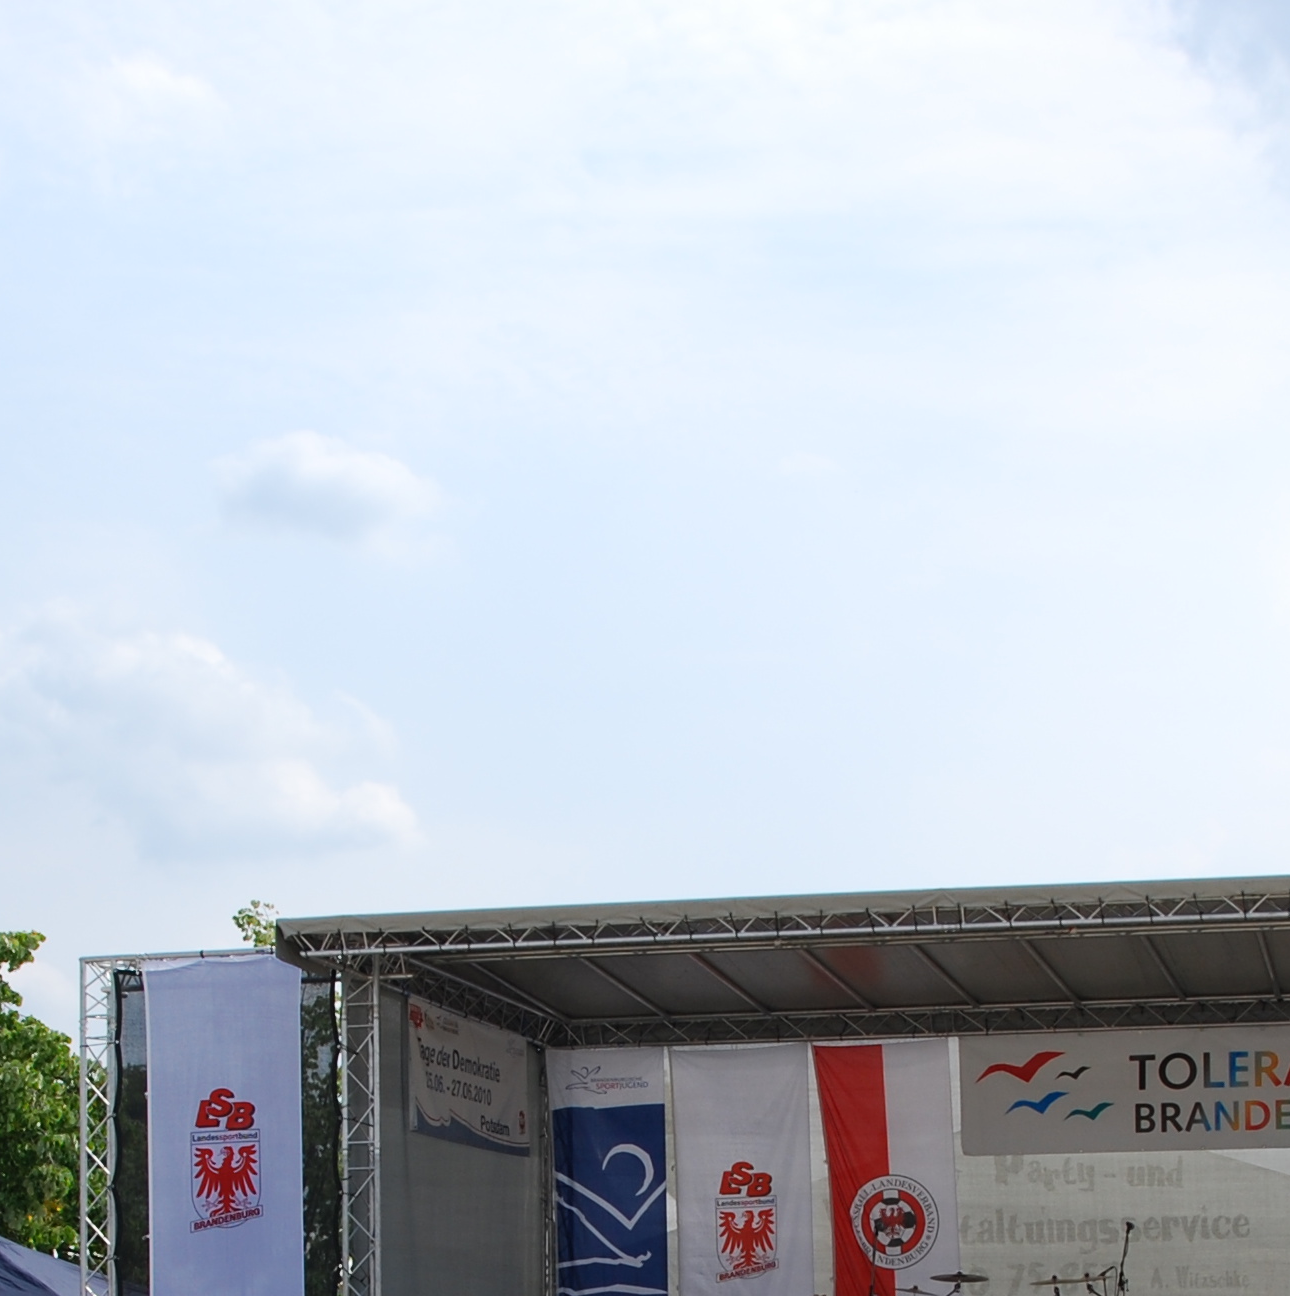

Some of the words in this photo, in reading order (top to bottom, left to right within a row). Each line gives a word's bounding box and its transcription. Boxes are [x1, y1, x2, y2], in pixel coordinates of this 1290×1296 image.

[437, 1047, 452, 1069] der
[453, 1050, 501, 1083] Demokratie
[451, 1079, 492, 1106] 27.06.2010
[596, 1081, 649, 1090] SPORTJUGEND
[195, 1088, 256, 1131] LSB
[192, 1131, 258, 1142] Landessportbund
[480, 1115, 510, 1136] Potsdam
[719, 1161, 772, 1197] LSB
[716, 1198, 775, 1207] Landessportbund
[193, 1207, 260, 1231] BRANDENBURG
[719, 1261, 776, 1281] BRANDENBURG
